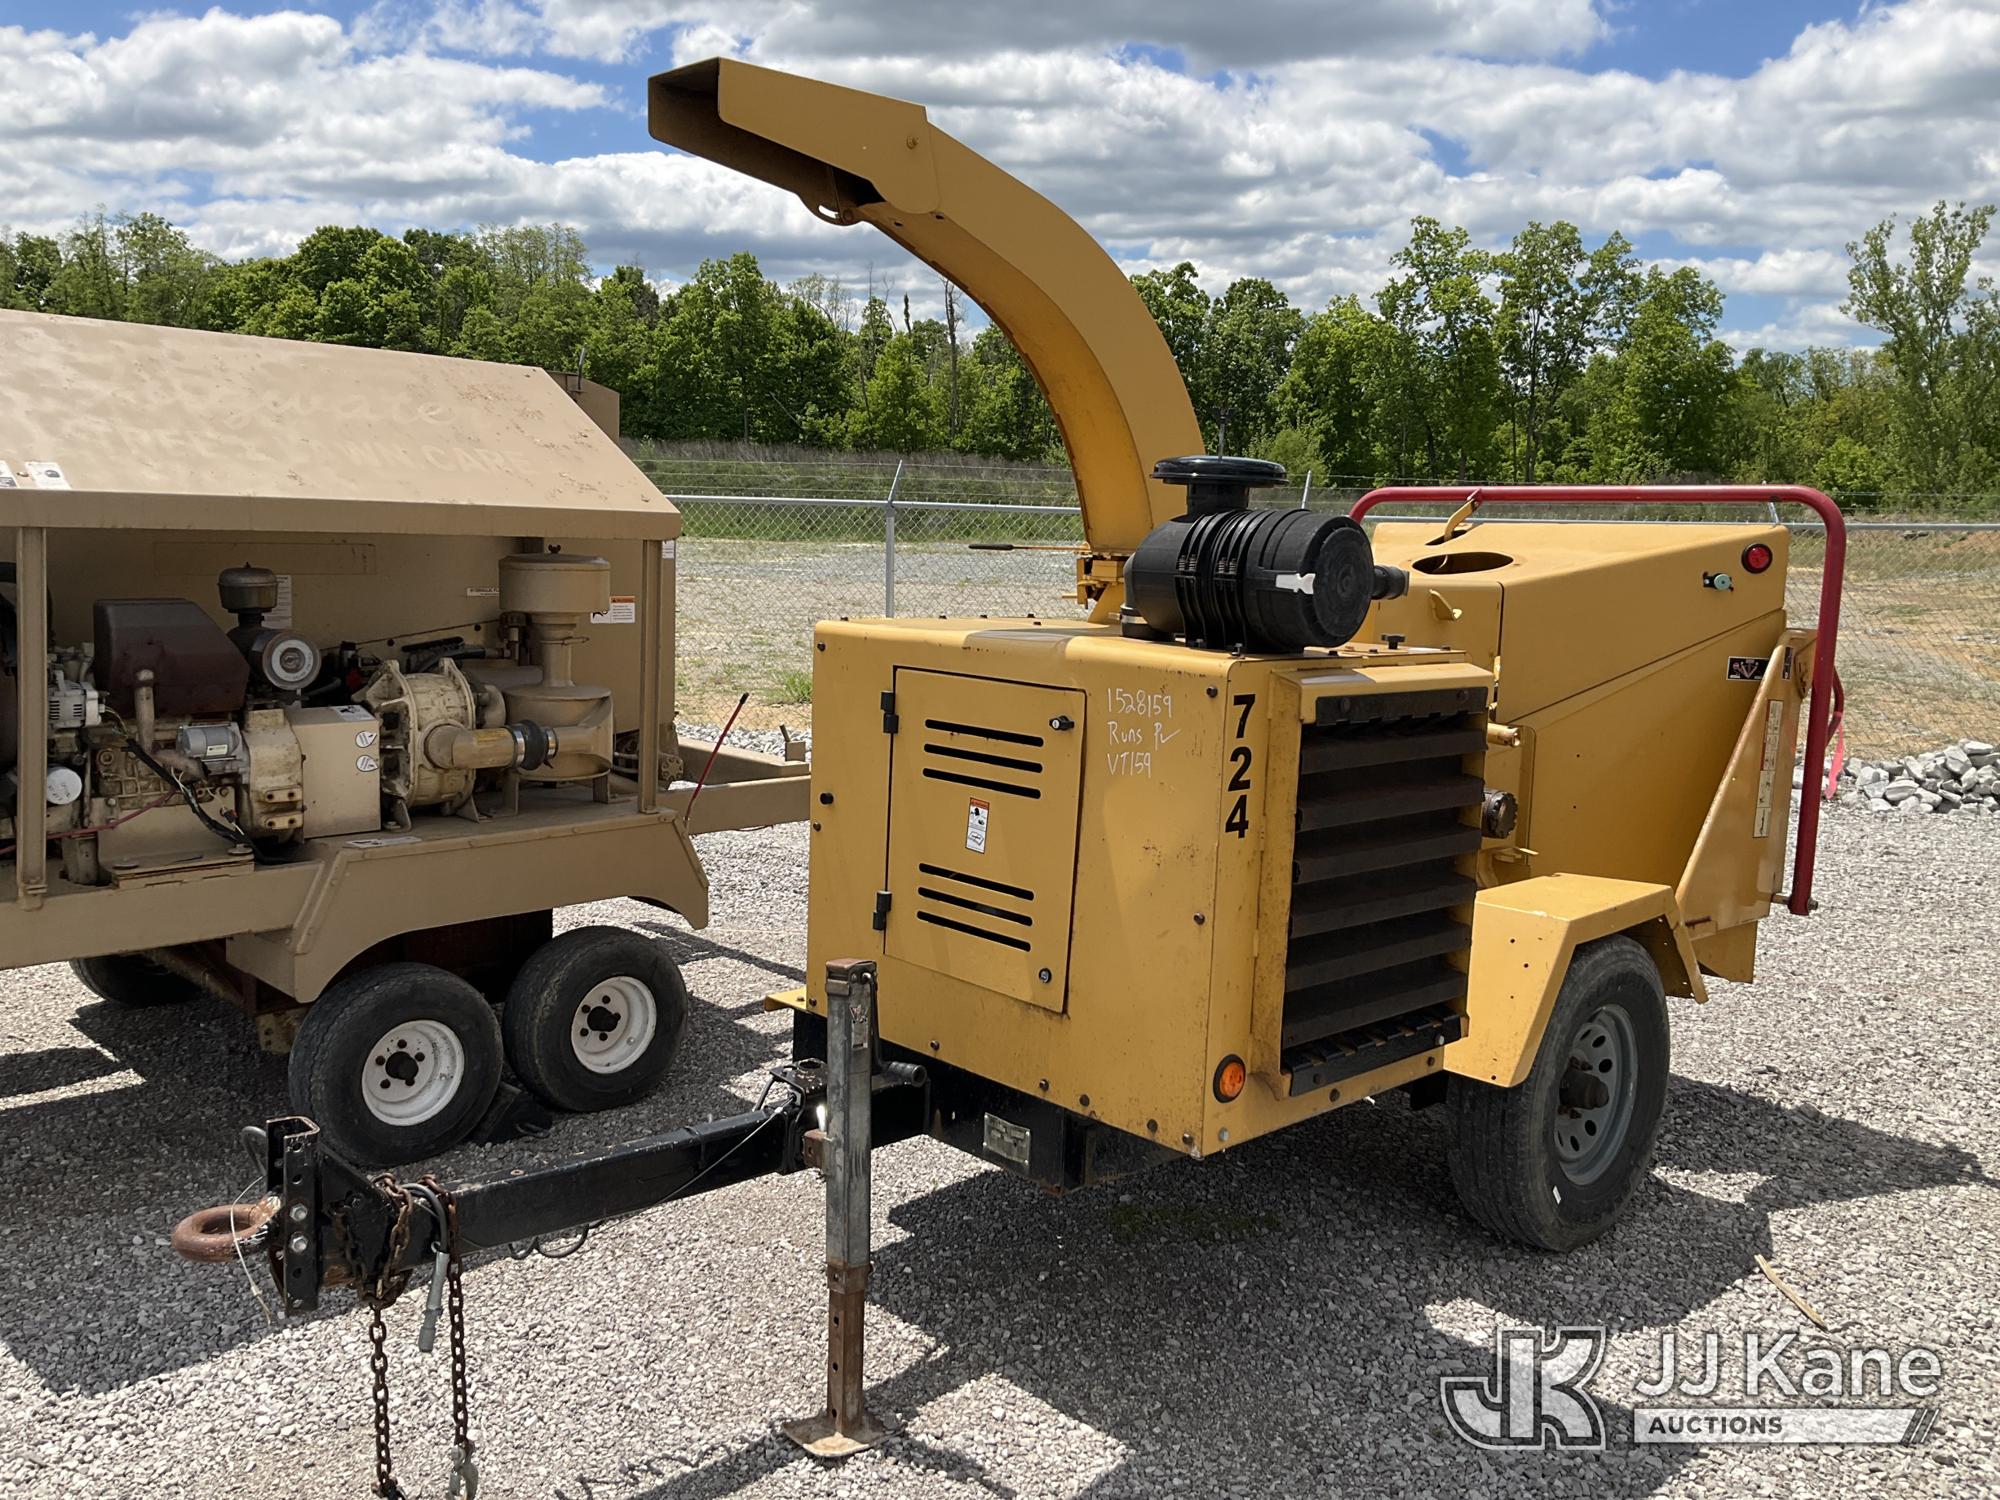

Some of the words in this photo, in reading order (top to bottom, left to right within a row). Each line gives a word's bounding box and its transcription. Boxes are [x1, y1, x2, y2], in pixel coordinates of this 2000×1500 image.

[1107, 687, 1172, 719] 1528159
[1107, 721, 1143, 746] Runs
[1107, 751, 1151, 779] VT159
